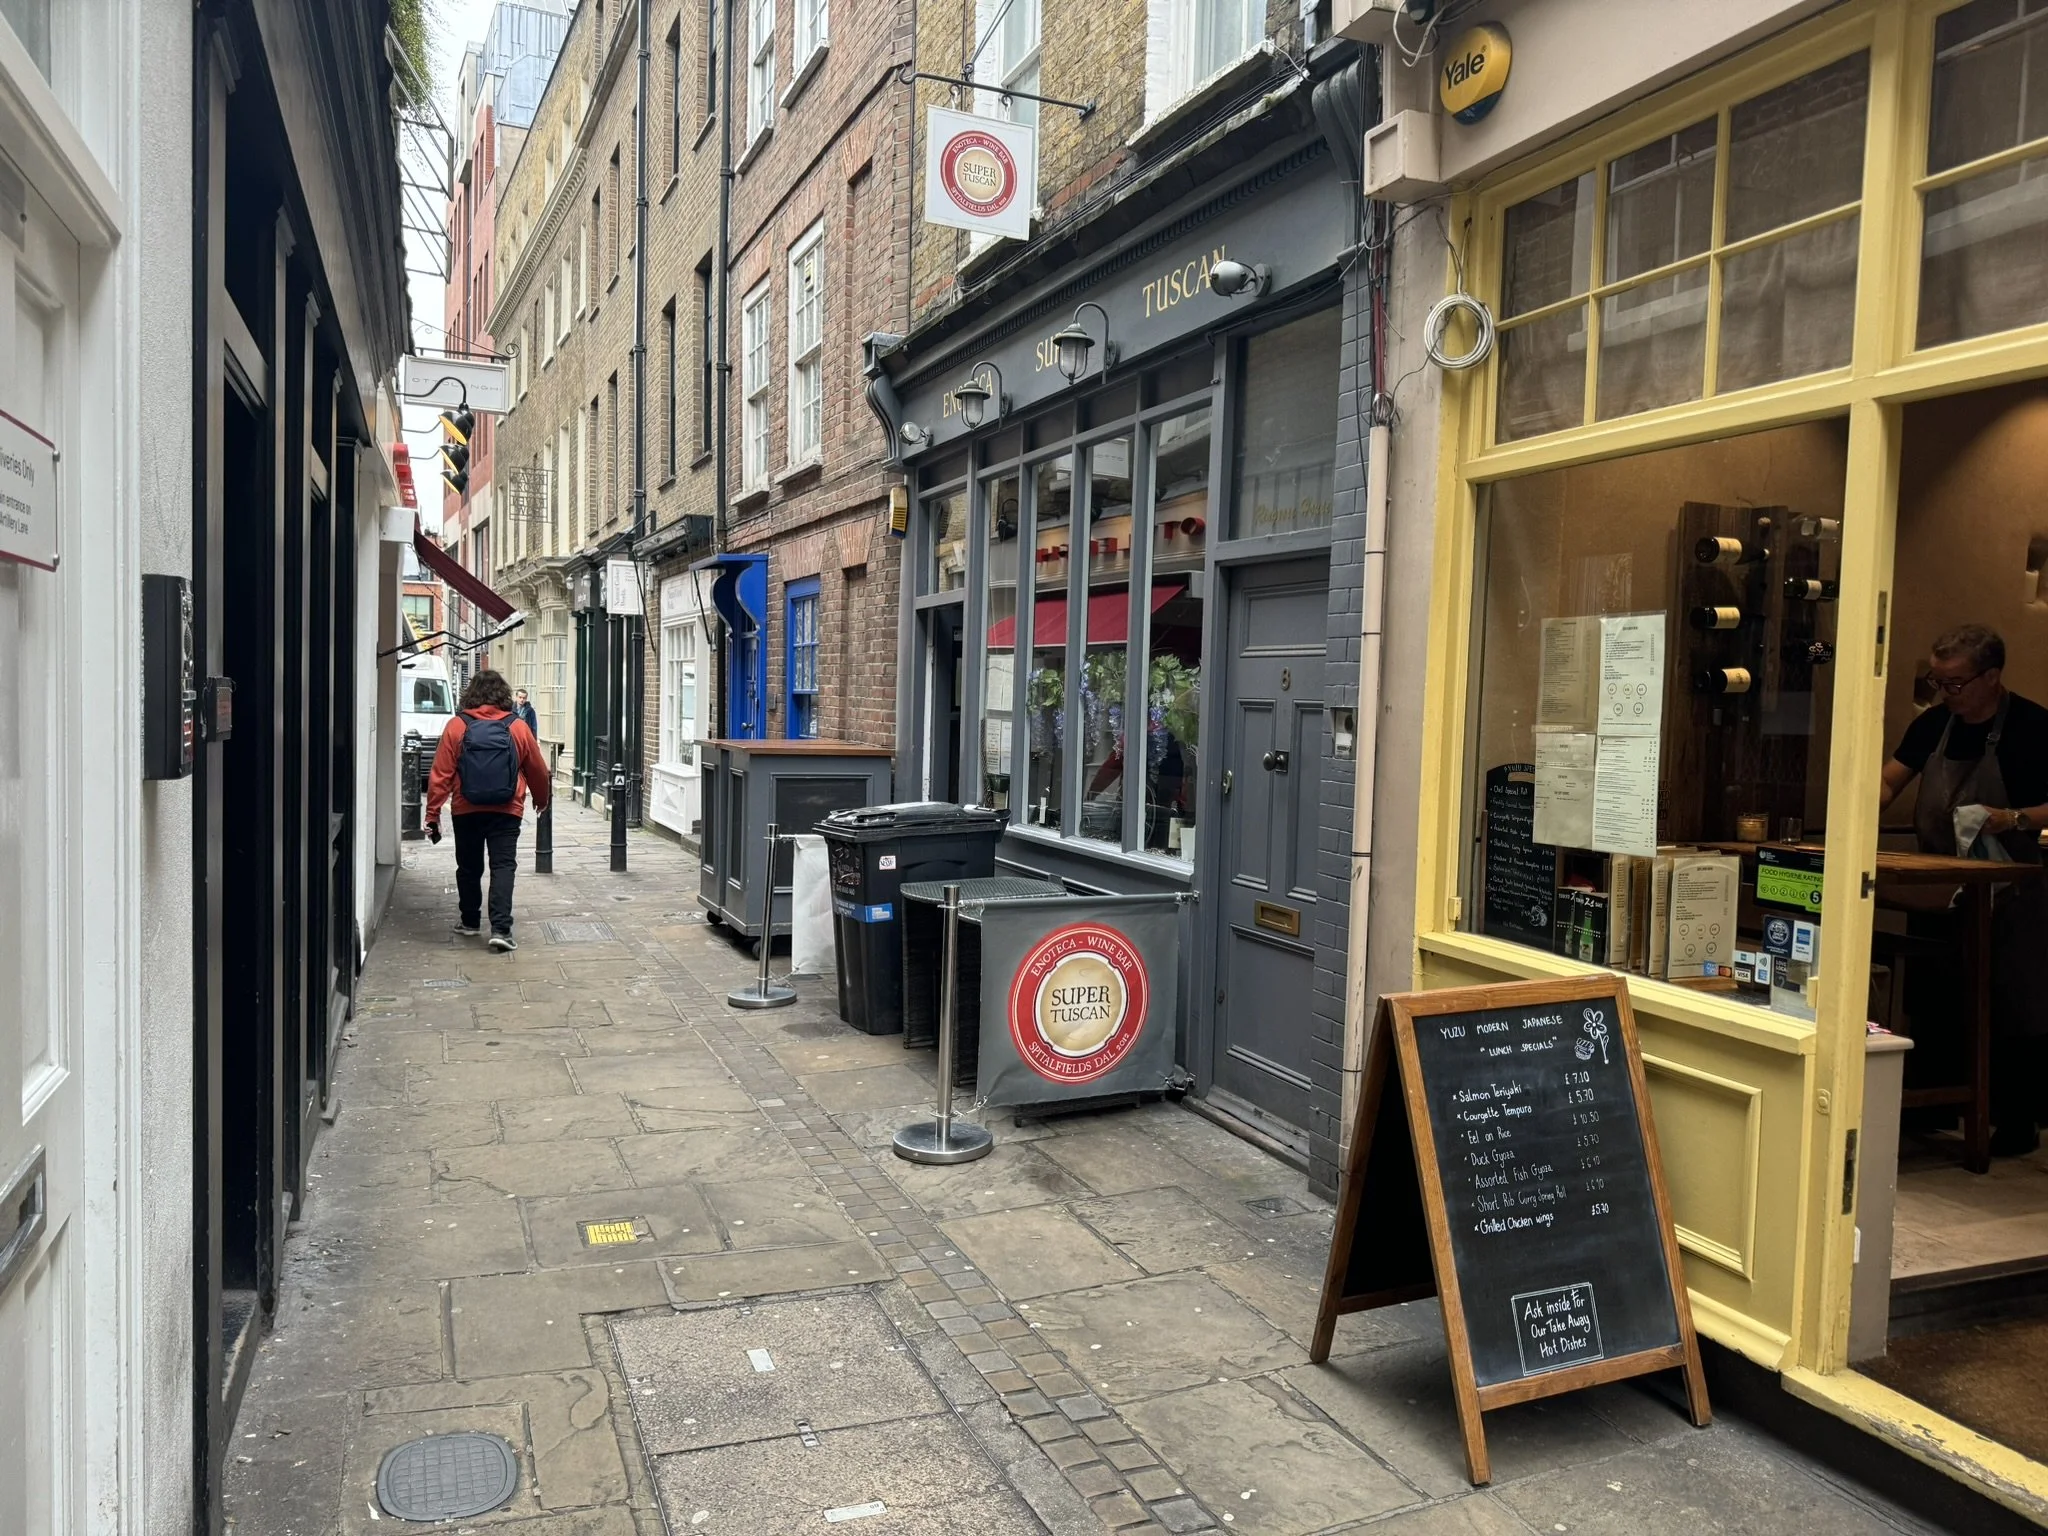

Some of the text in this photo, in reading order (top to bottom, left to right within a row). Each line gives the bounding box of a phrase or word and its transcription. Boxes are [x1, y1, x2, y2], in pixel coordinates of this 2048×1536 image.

[1444, 52, 1485, 90] Yale
[952, 138, 978, 154] ENOTECA
[983, 139, 999, 153] WINE
[998, 150, 1009, 164] BAR
[962, 172, 997, 187] TUSCAN
[963, 162, 997, 178] SUPER
[412, 377, 502, 393] OTTOLNGHI
[943, 370, 993, 418] ENOCA
[22, 457, 35, 487] Only
[1761, 867, 1778, 876] FOOD
[1779, 870, 1802, 880] HYGIENE
[1031, 938, 1077, 978] ENOTECA
[1087, 935, 1117, 956] WINE
[1115, 949, 1133, 973] BAR
[1737, 971, 1749, 979] VISA
[1051, 985, 1111, 1007] SUPER
[1050, 1004, 1111, 1023] TUSCAN
[1440, 1015, 1563, 1039] YUZU MODERN JAPANESE
[1028, 1033, 1131, 1074] SPITALFIELDS DAL 2012
[1459, 1089, 1491, 1102] Salmon
[1490, 1080, 1522, 1099] Teriyaki
[1502, 1103, 1532, 1118] Tempura
[1467, 1130, 1479, 1144] Eel
[1485, 1133, 1494, 1142] on
[1497, 1126, 1512, 1140] Rice
[1471, 1152, 1490, 1166] Duck
[1492, 1149, 1516, 1169] Gyoza
[1475, 1170, 1509, 1189] Assorted
[1513, 1166, 1529, 1182] Fish
[1531, 1163, 1554, 1181] Gyoza
[1477, 1194, 1501, 1213] Short
[1503, 1191, 1515, 1208] Rib
[1556, 1184, 1567, 1199] Roll
[1480, 1218, 1506, 1235] Grilled
[1507, 1216, 1534, 1230] Chicken
[1536, 1212, 1554, 1228] wings
[1524, 1289, 1585, 1320] Ask inside For
[1531, 1314, 1591, 1339] Our Take Away
[1539, 1335, 1587, 1358] Hot Dishes
